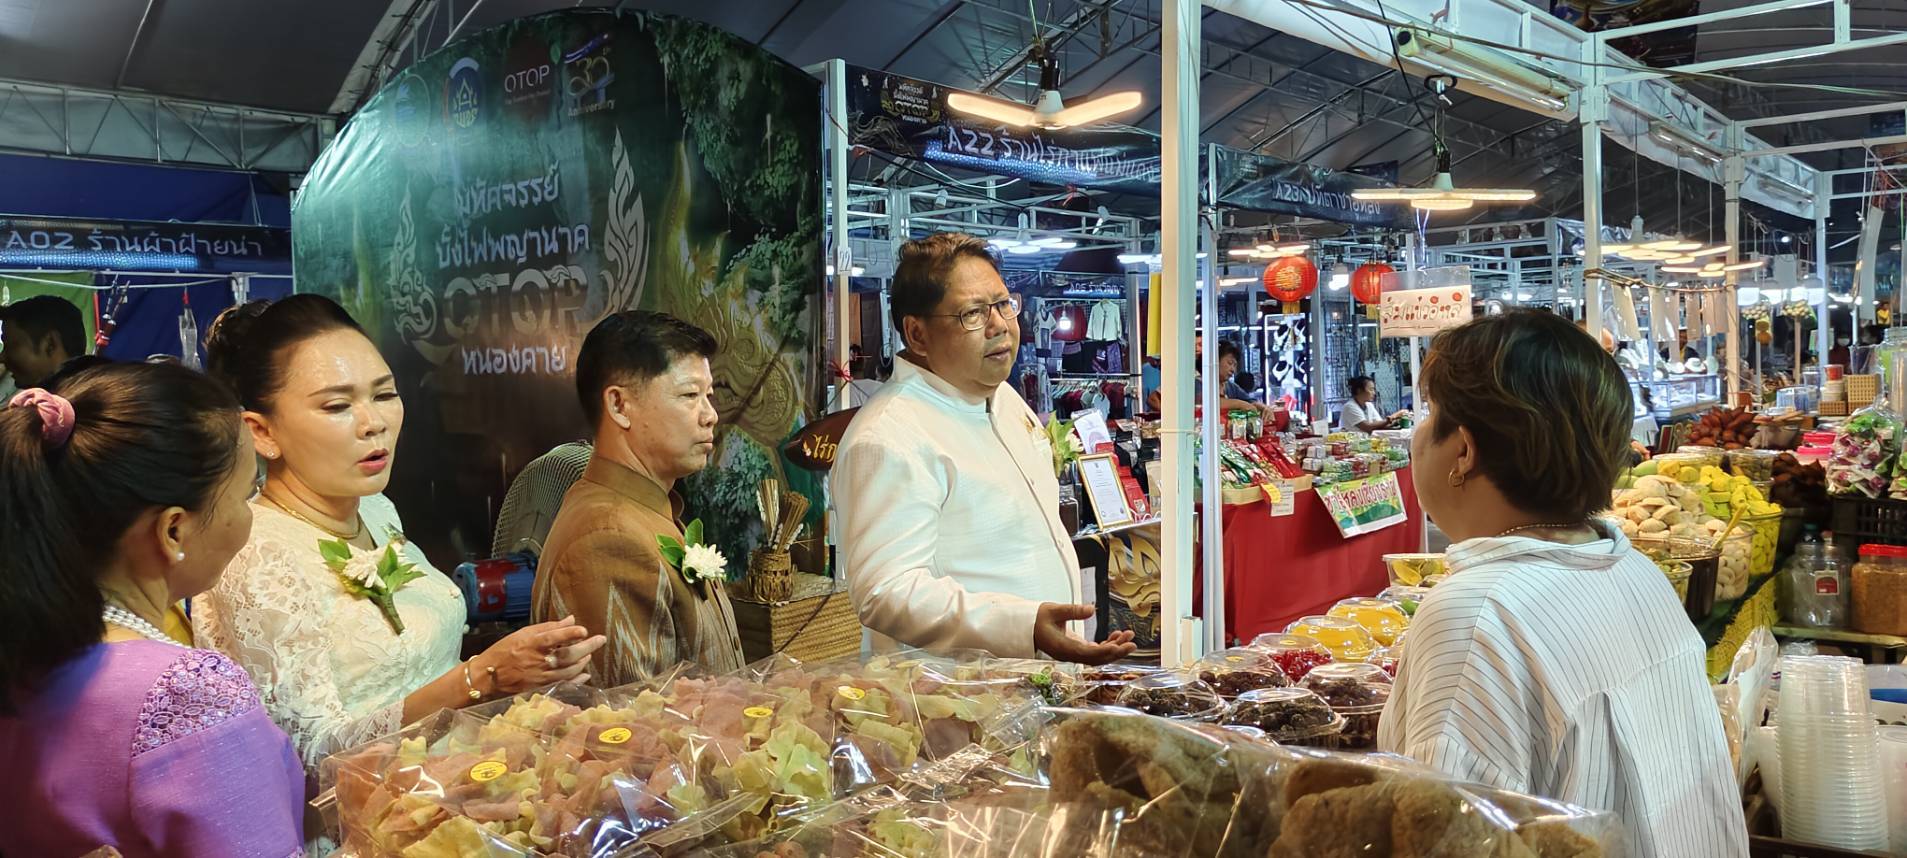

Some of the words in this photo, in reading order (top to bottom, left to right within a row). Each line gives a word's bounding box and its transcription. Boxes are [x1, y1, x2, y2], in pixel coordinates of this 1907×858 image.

[504, 64, 550, 93] OTOP
[946, 127, 995, 156] A22
[1275, 182, 1299, 202] A23
[6, 231, 75, 250] A02
[443, 264, 588, 339] OTOP
[461, 342, 567, 375] หนองคาย
